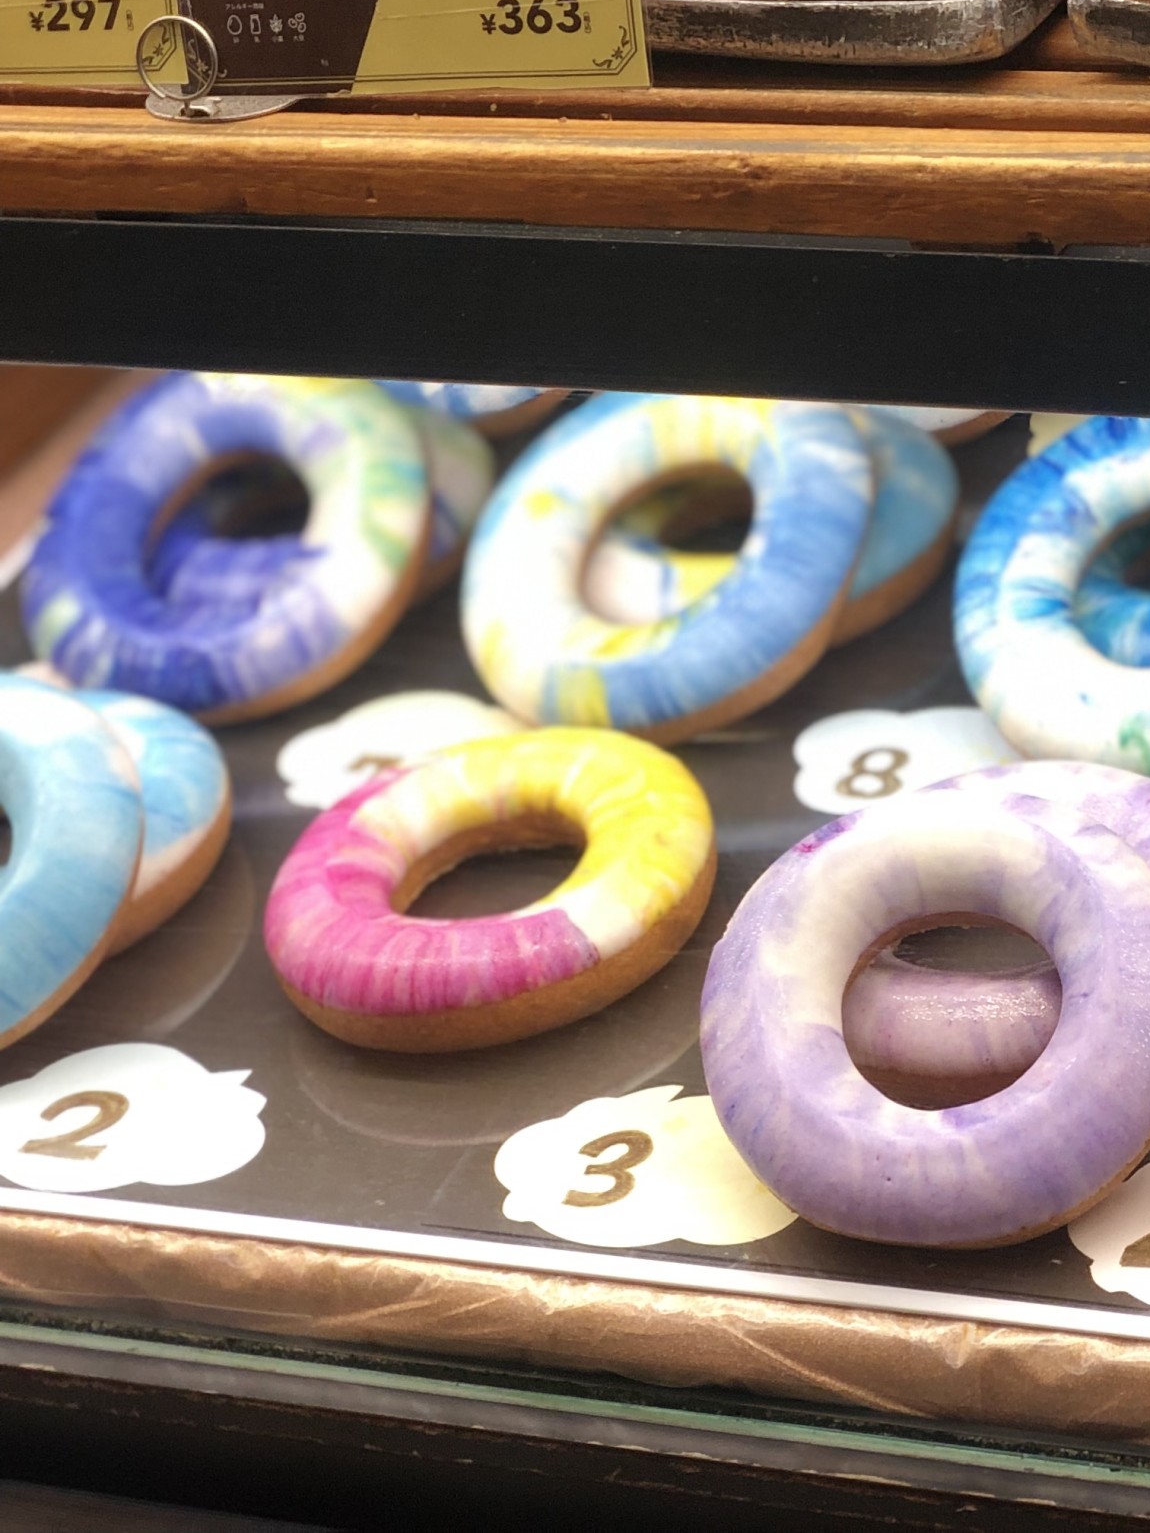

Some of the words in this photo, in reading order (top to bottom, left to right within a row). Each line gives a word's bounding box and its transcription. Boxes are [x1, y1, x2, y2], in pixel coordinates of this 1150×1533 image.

[836, 747, 908, 799] 8
[17, 1090, 130, 1160] 2
[561, 1130, 654, 1208] 3
